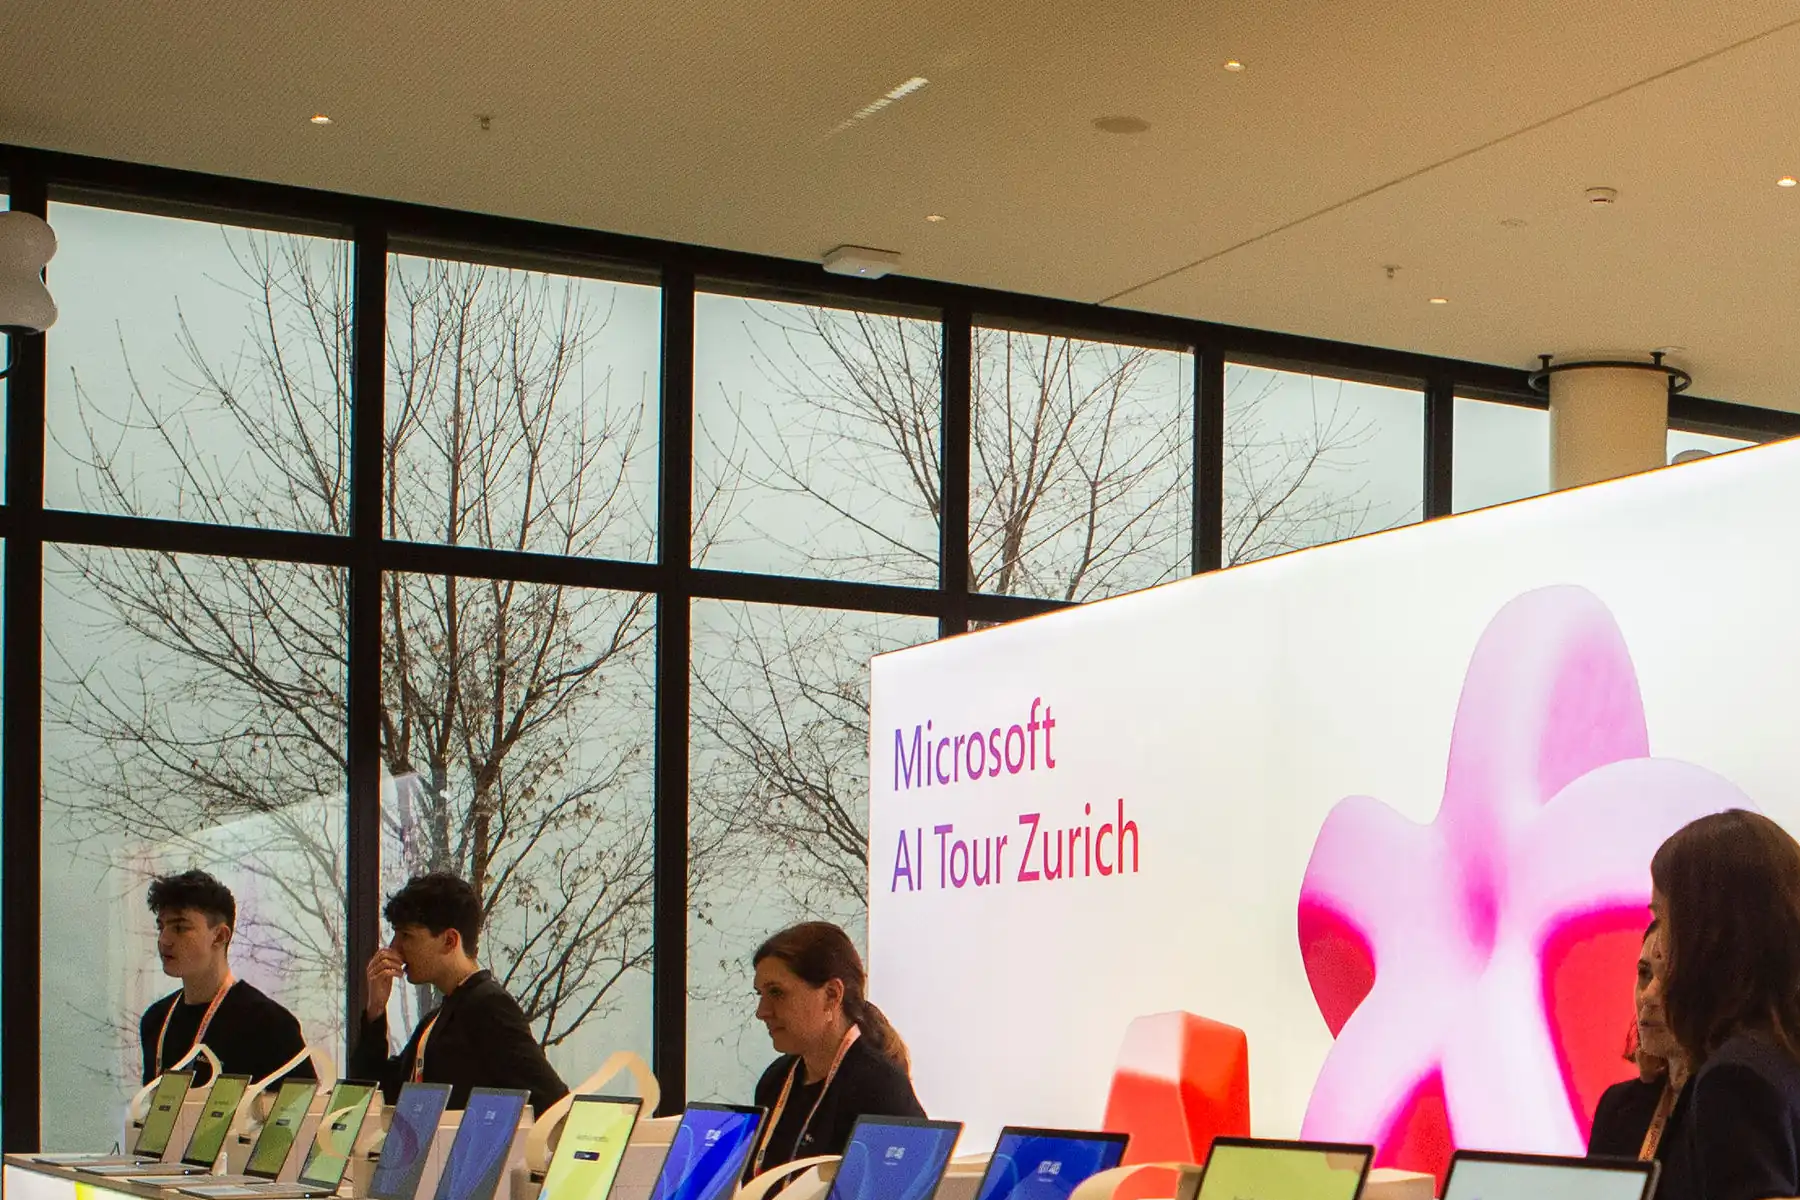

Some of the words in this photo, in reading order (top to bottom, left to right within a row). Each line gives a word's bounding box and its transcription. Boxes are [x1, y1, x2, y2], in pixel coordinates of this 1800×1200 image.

[895, 697, 1055, 791] Microsoft
[892, 828, 921, 892] AI
[934, 824, 1007, 888] Tour
[1018, 799, 1138, 882] Zurich
